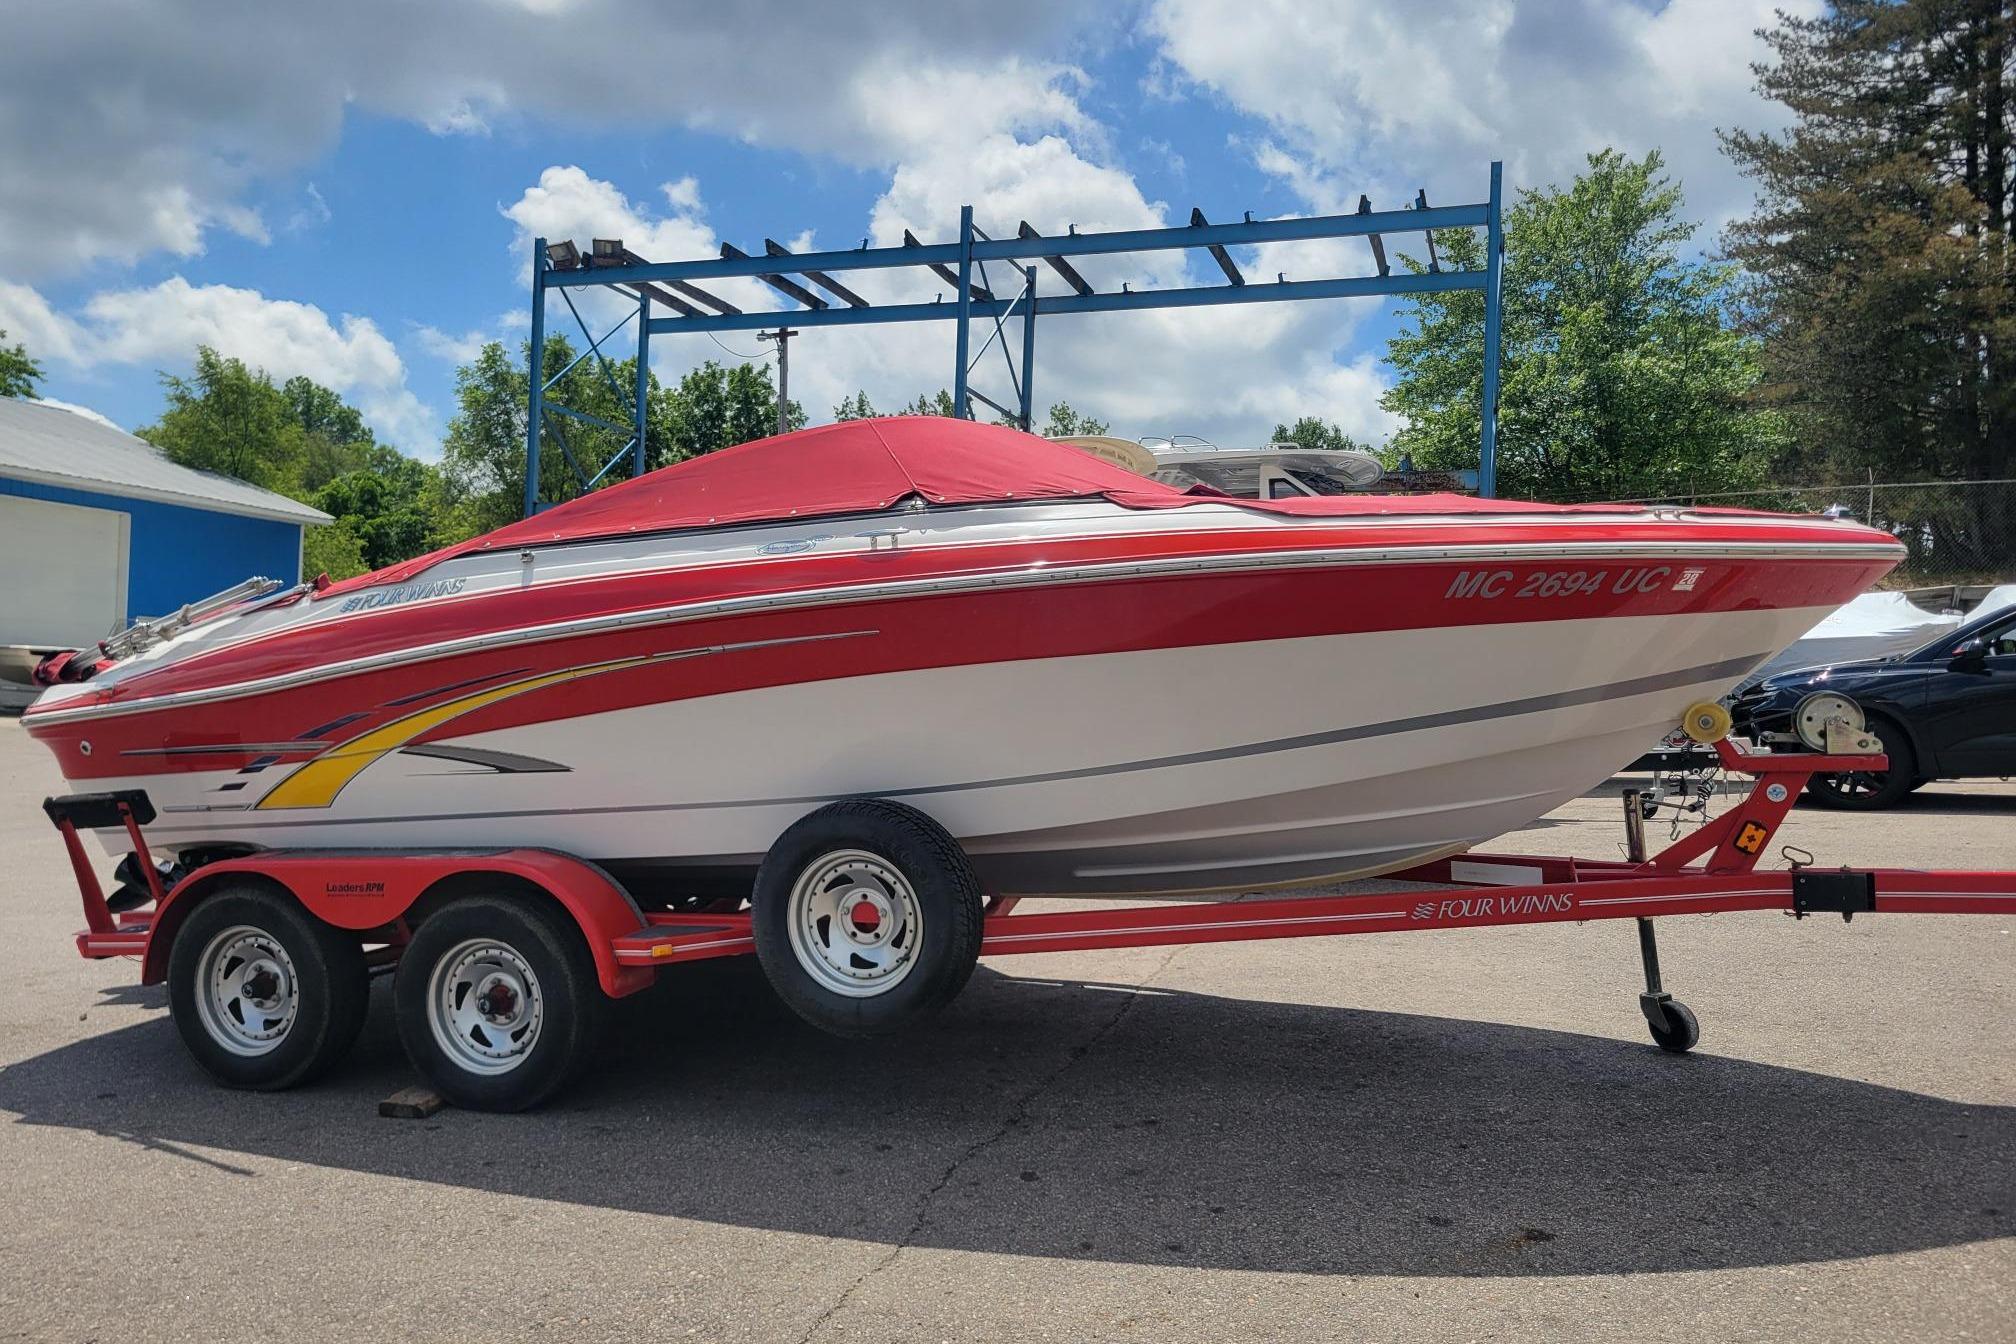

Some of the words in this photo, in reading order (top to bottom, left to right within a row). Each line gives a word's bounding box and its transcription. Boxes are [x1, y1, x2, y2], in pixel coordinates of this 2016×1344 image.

[359, 587, 405, 610] FOUR
[405, 578, 466, 601] WINNS
[1445, 571, 1513, 598] MC
[1514, 571, 1606, 598] 2694
[1612, 566, 1670, 594] UC
[365, 882, 384, 892] RPM
[1438, 898, 1494, 920] FOUR
[1500, 893, 1575, 914] WINNS
